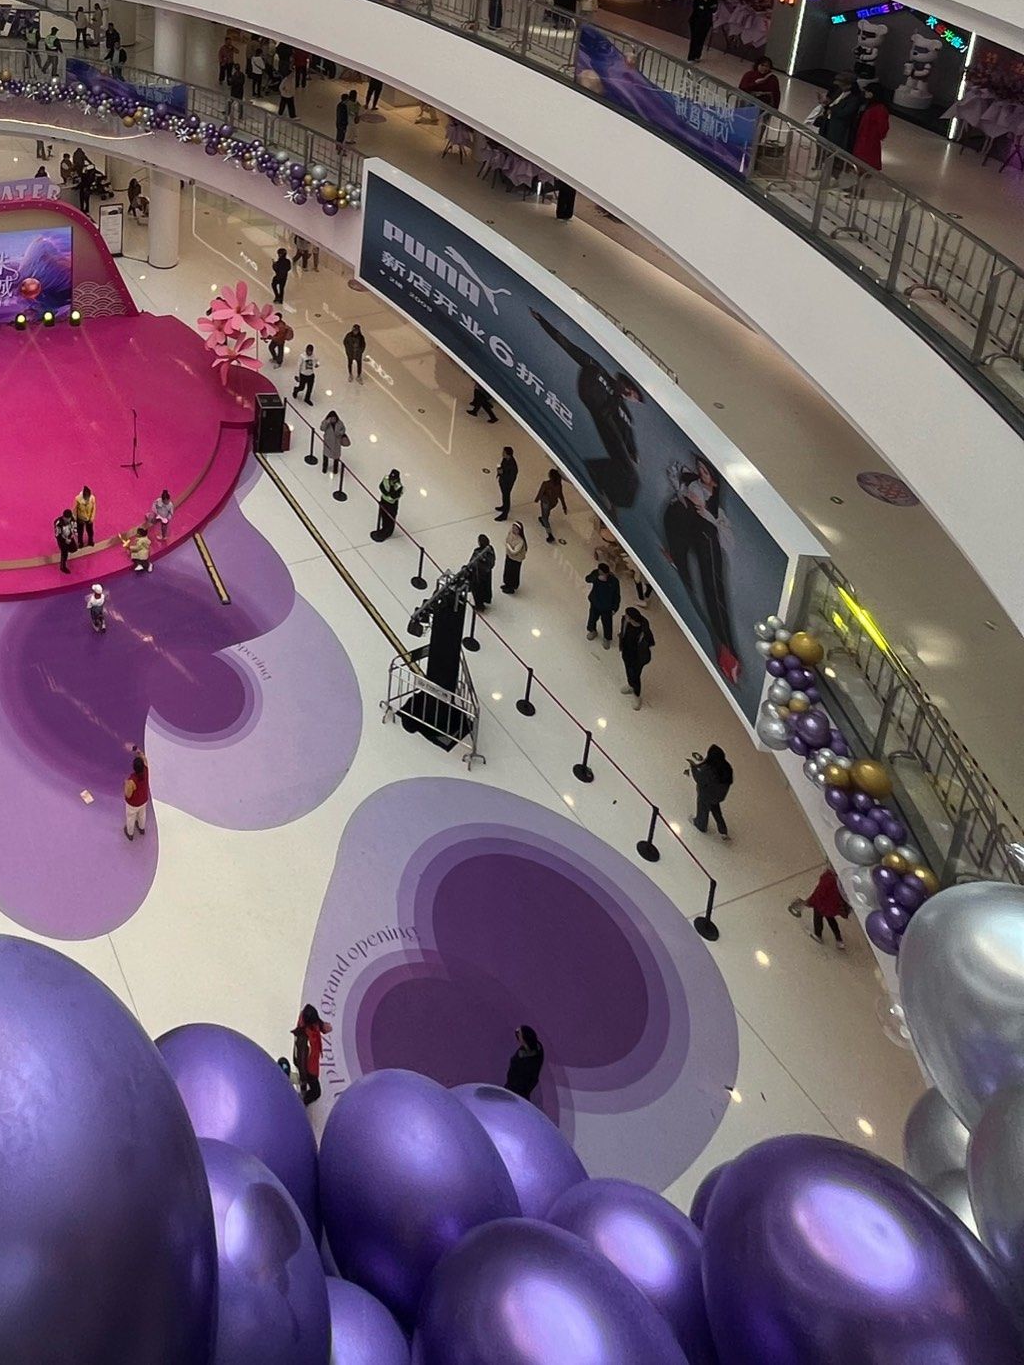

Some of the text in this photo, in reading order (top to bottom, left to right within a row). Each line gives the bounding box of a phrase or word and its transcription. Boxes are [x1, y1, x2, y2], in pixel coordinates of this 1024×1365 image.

[382, 219, 480, 307] PUMA
[320, 954, 352, 1017] grand
[347, 925, 422, 960] opening
